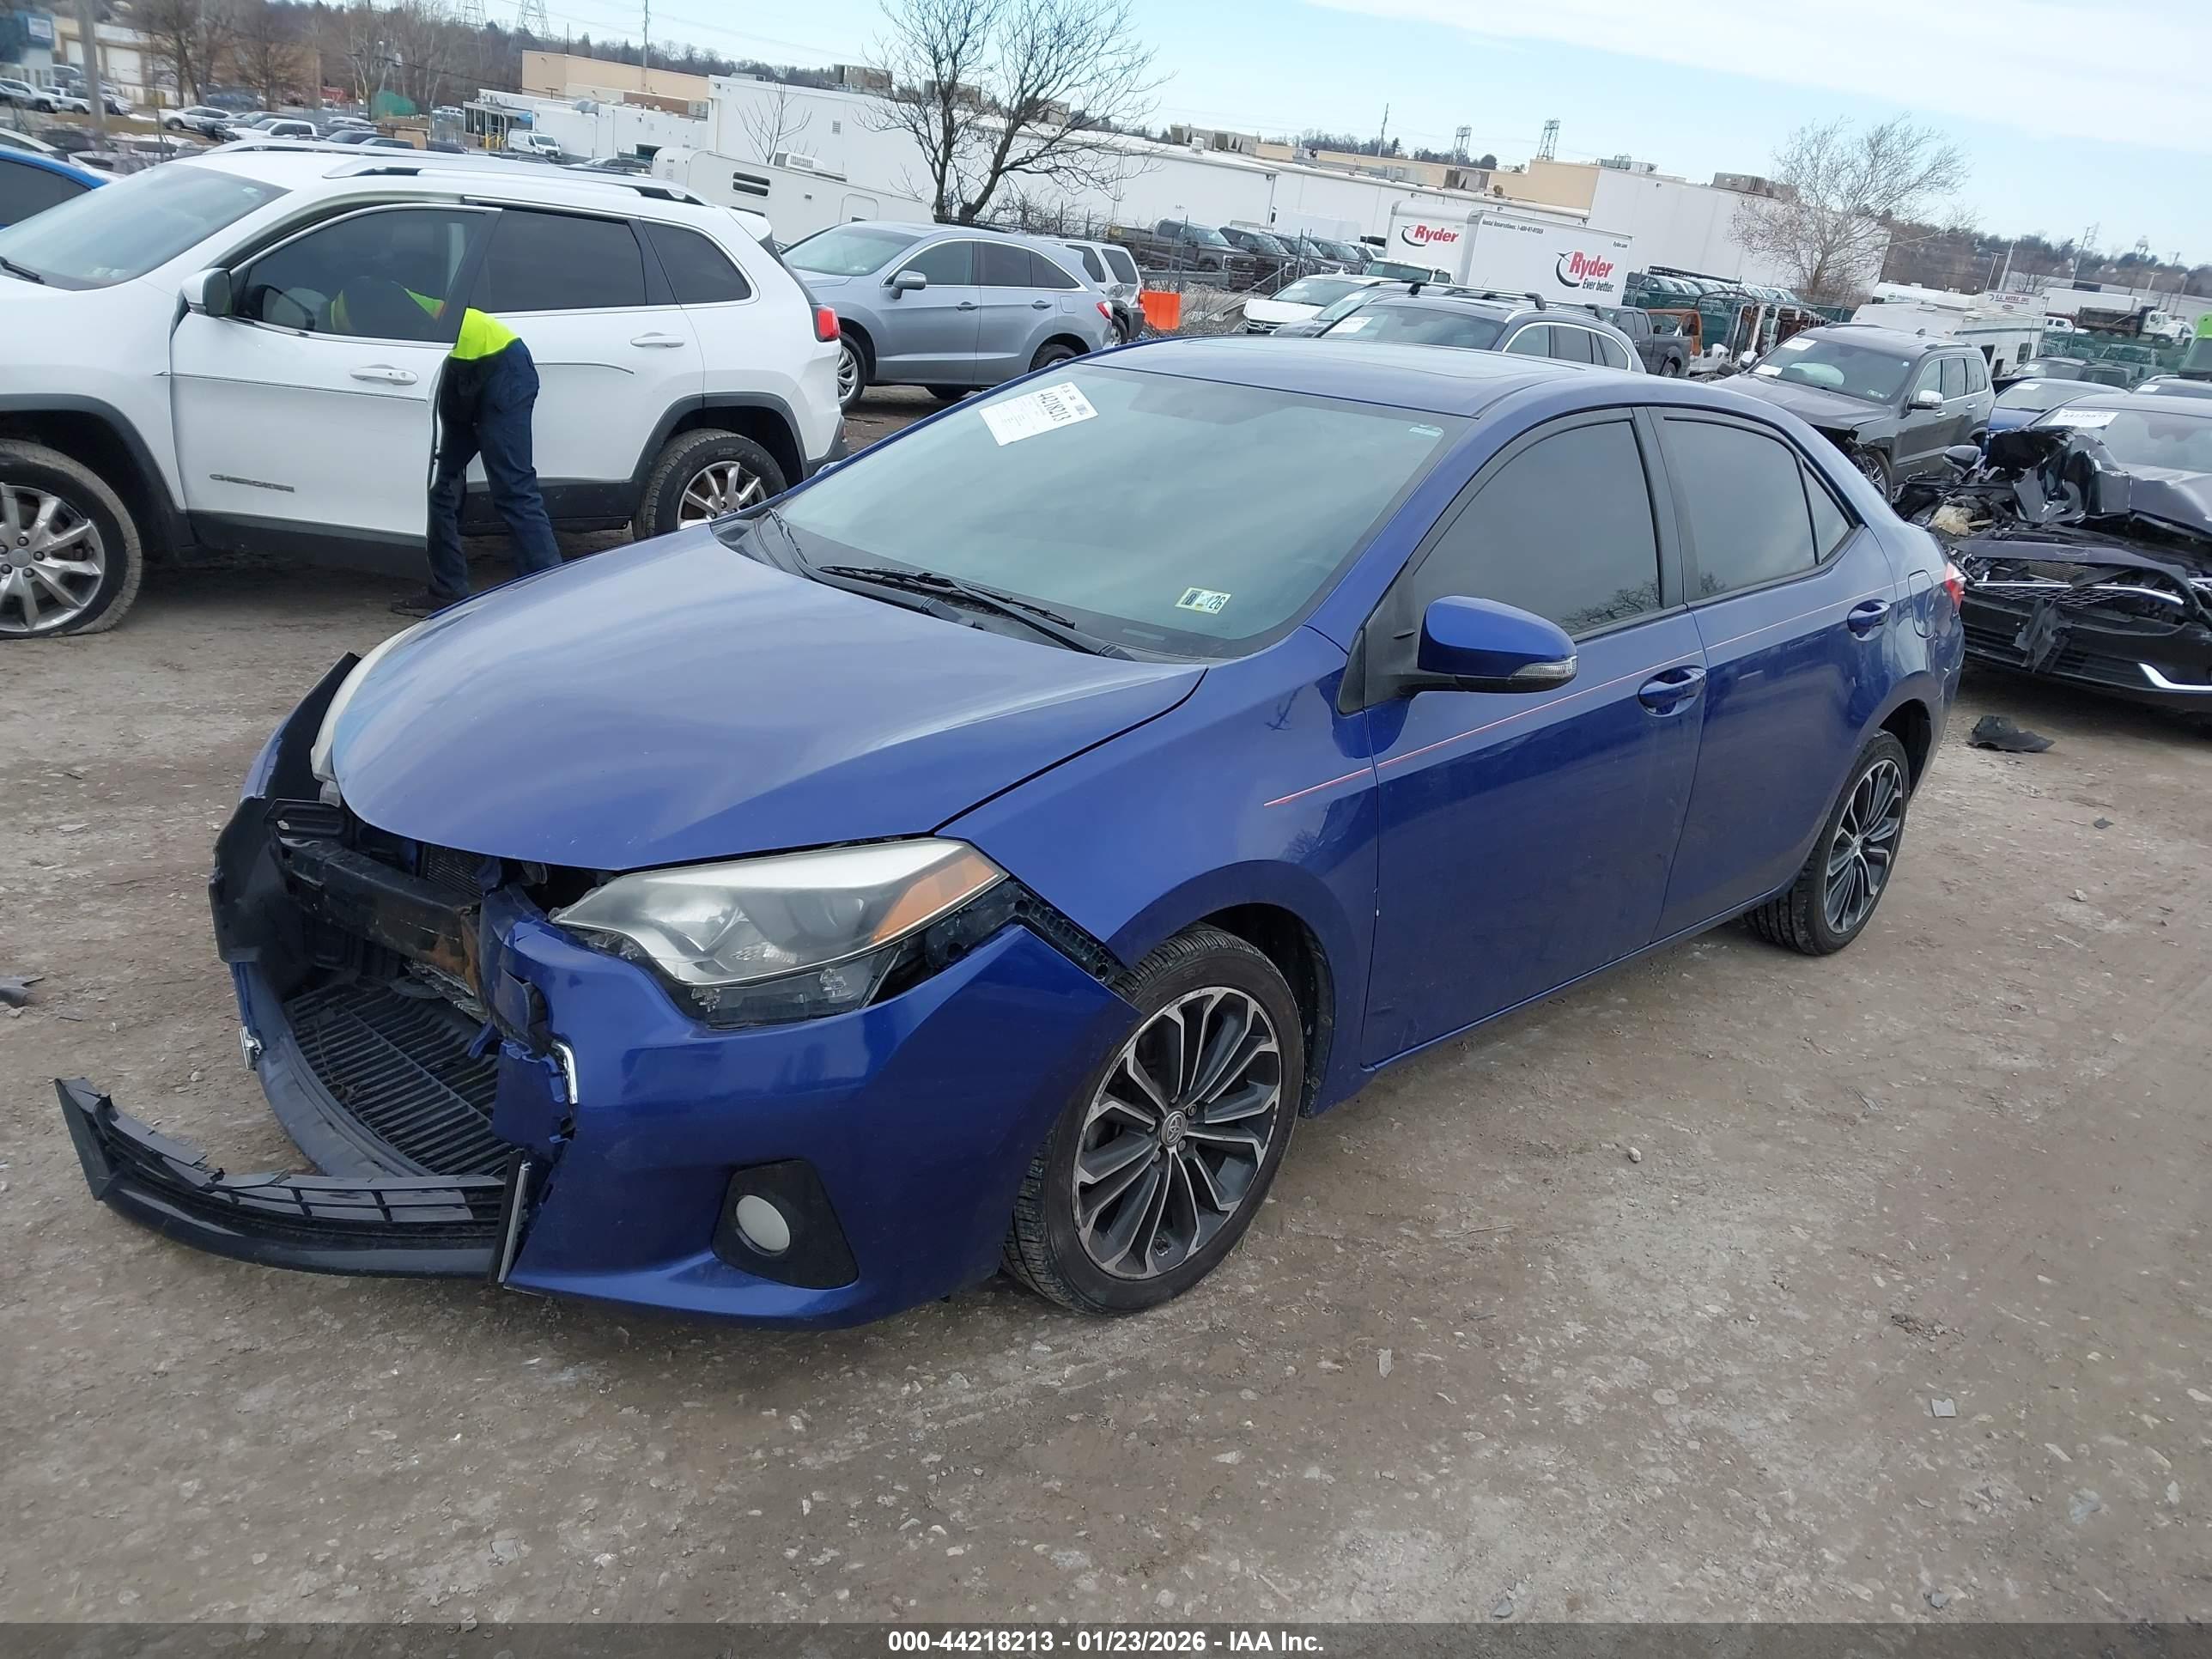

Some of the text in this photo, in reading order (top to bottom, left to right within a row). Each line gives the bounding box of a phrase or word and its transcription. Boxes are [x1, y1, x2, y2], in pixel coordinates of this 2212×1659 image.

[1414, 224, 1459, 242] Ryder
[1569, 251, 1613, 279] Ryder
[1582, 278, 1613, 292] Ever better.
[1037, 392, 1072, 422] 44218213
